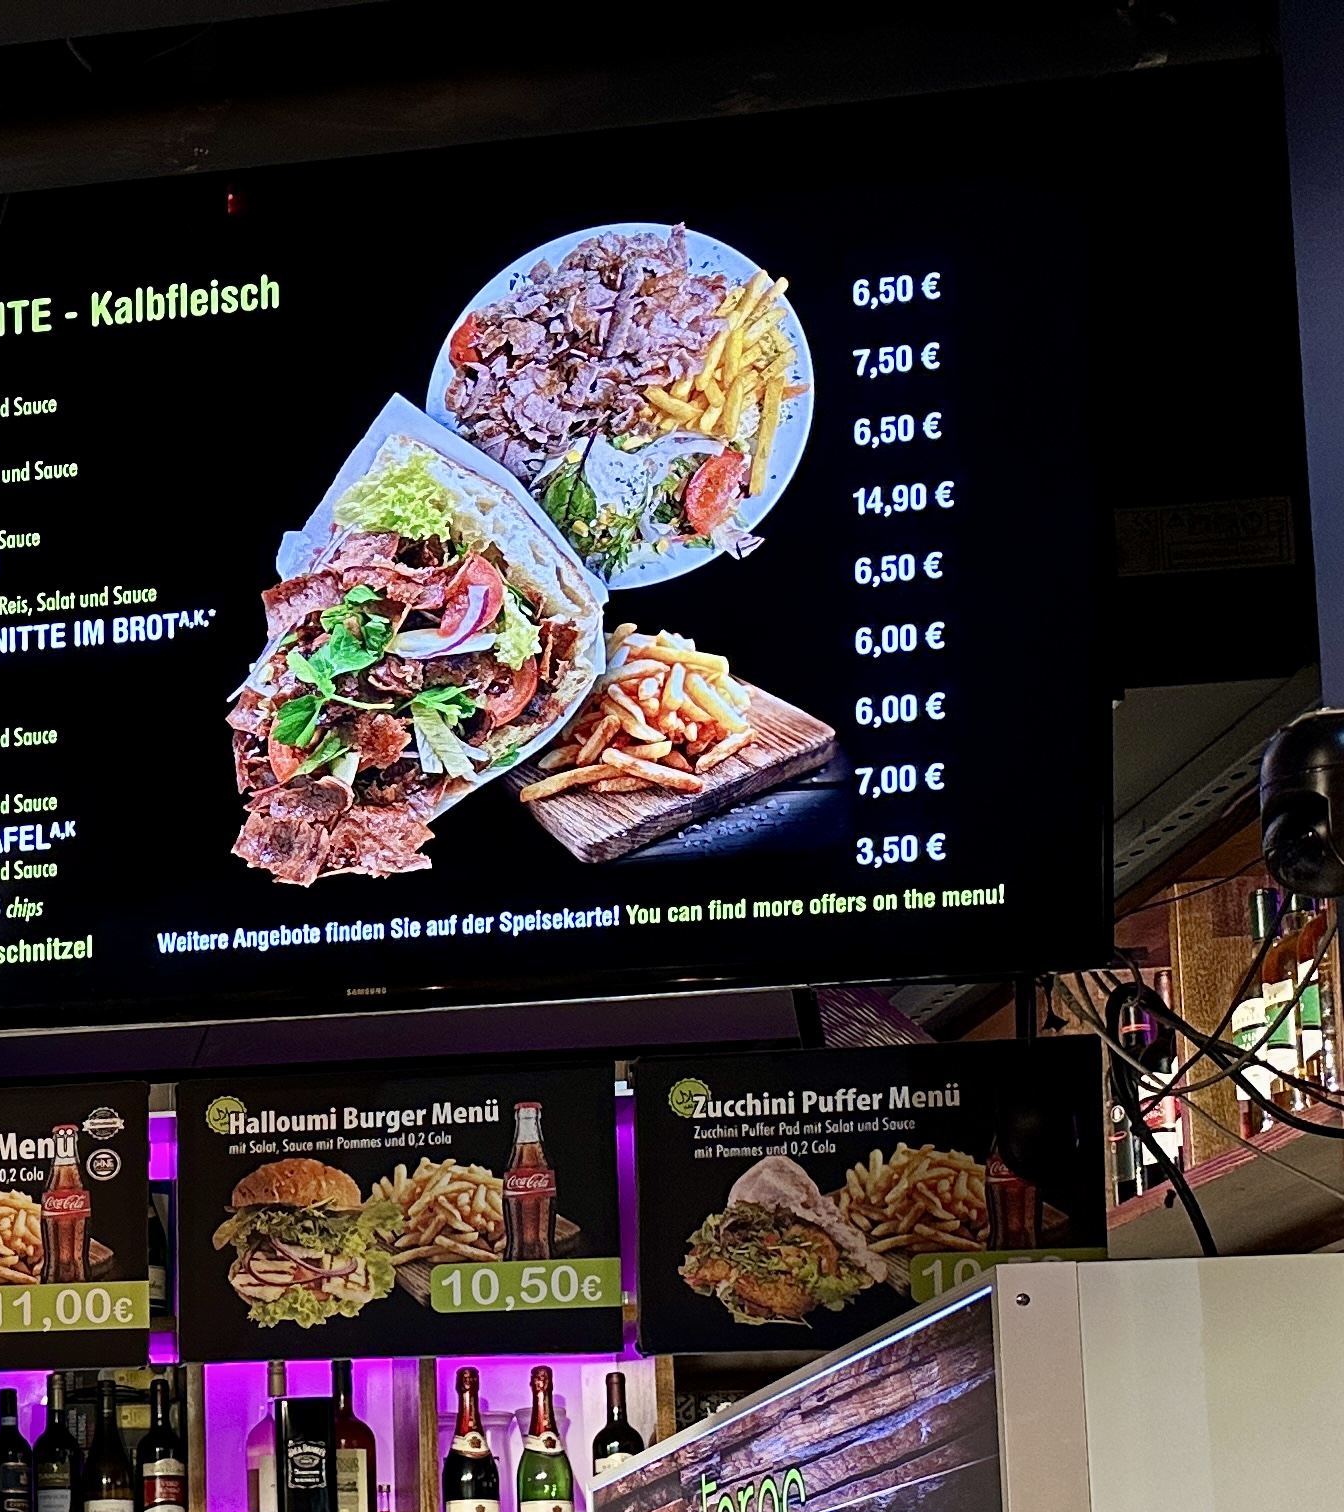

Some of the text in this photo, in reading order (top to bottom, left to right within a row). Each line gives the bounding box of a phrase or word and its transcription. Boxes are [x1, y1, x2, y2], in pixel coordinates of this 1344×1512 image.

[91, 274, 280, 328] Kalbfleisch
[852, 273, 940, 310] 6,50 €
[852, 342, 940, 378] 7,50 €
[853, 412, 942, 448] 6,50 €
[853, 481, 954, 517] 14,90 €
[855, 763, 945, 798] 7,00 €
[856, 833, 946, 869] 3,50 €
[6, 897, 43, 921] chips
[157, 885, 1005, 954] Weitere Angebote finden Sie auf der Speisekarte! You can find more offers on the menu!
[229, 1099, 499, 1137] Halloumi Burger Menü
[692, 1083, 960, 1118] Zucchini Puffer Menü
[0, 1170, 17, 1185] 0,2
[20, 1168, 43, 1182] Cola
[441, 1265, 602, 1311] 10,50€
